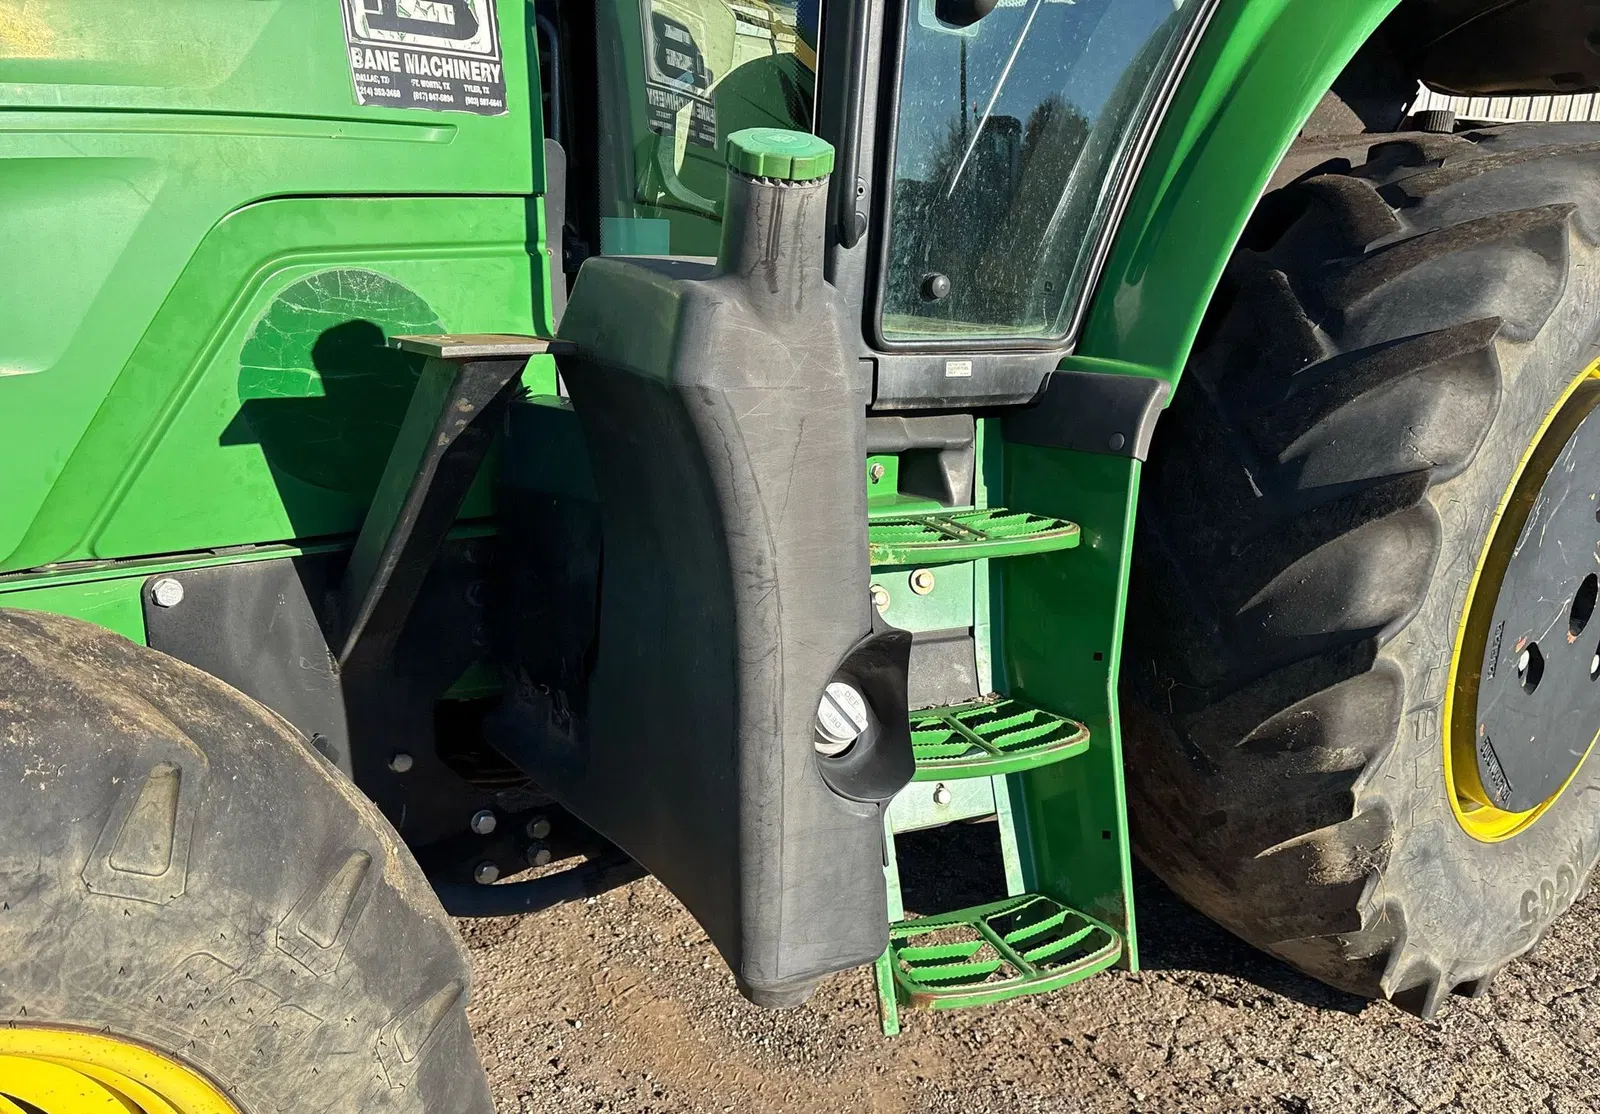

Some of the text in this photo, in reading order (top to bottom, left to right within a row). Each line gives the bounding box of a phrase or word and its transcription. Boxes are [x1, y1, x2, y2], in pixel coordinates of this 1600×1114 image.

[350, 46, 501, 84] BANE MACHINERY
[463, 84, 490, 95] TYLER, TX
[844, 691, 860, 707] DEF
